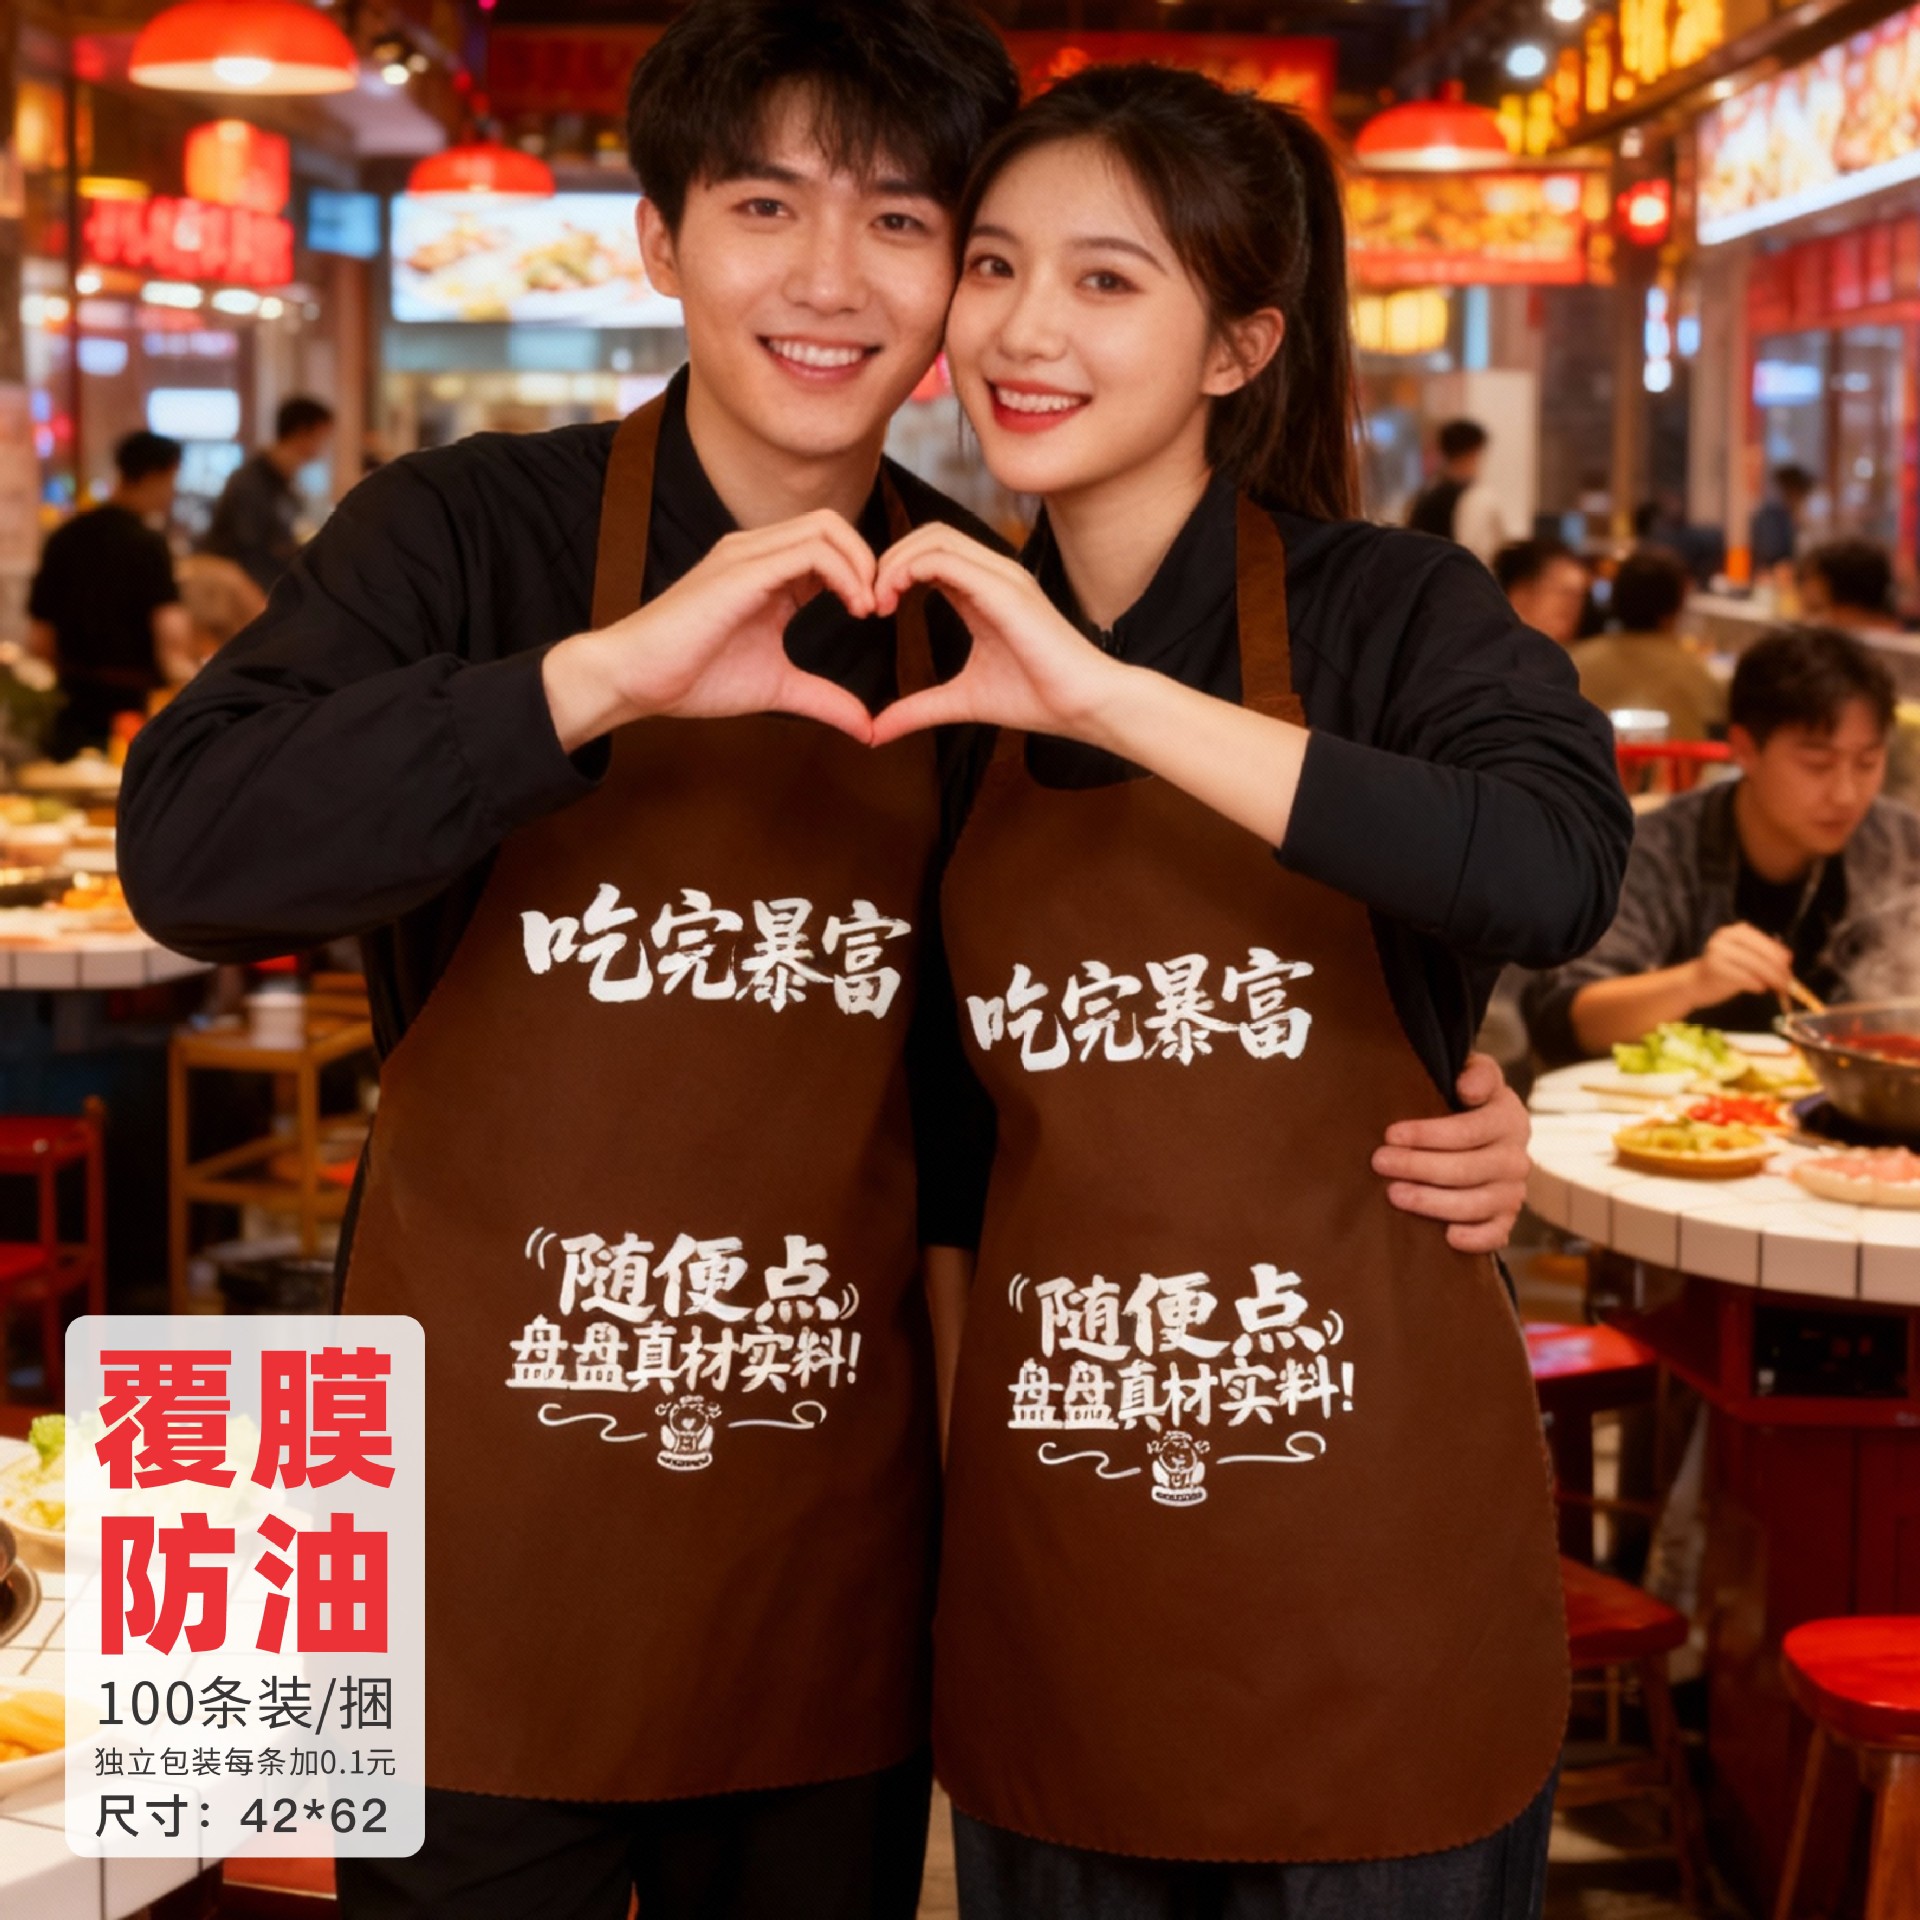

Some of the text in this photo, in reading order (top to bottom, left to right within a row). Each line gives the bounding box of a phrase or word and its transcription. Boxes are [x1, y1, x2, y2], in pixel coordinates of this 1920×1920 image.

[520, 883, 911, 1019] 吃完暴富
[967, 947, 1314, 1072] 吃完暴富
[560, 1231, 839, 1323] 随便点
[1035, 1263, 1327, 1362] 随便点
